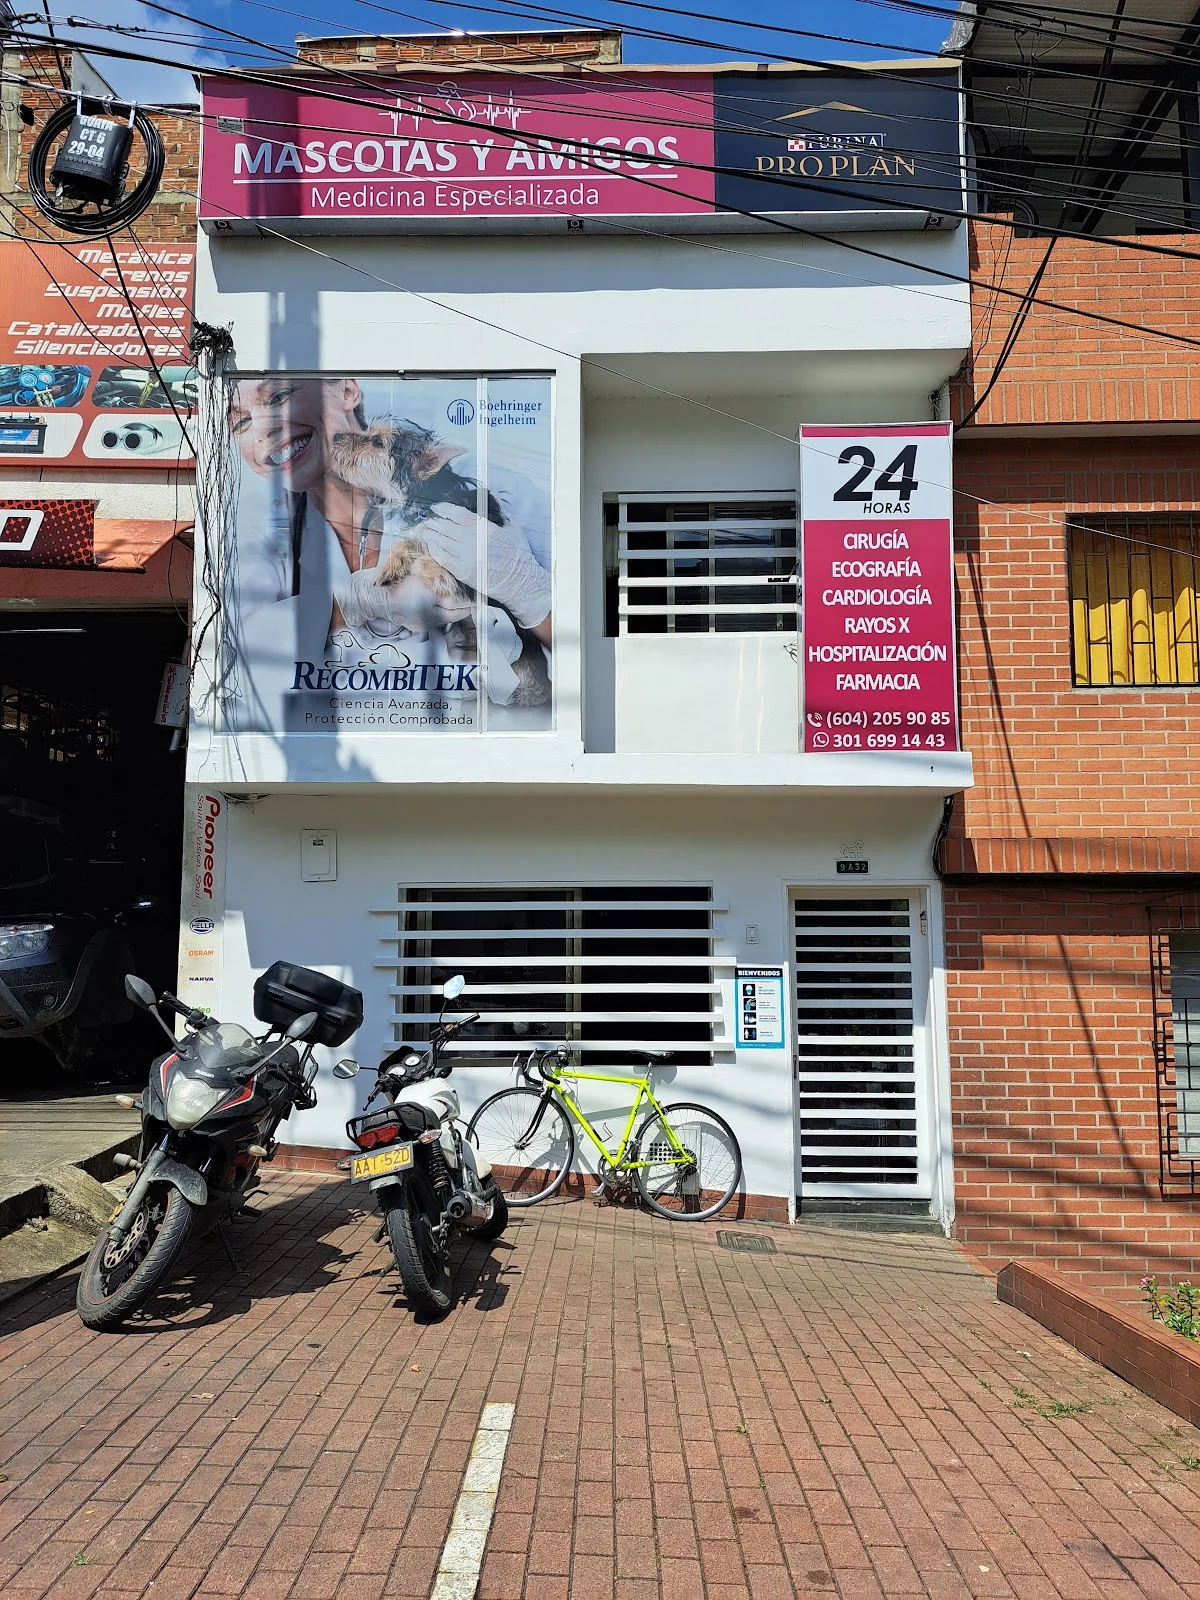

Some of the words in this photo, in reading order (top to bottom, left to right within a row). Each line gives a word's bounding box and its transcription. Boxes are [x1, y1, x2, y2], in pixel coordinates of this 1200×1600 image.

[67, 140, 106, 160] 29-04
[233, 139, 458, 174] MASCOTAS
[468, 138, 494, 171] Y
[505, 136, 680, 171] AMIGOS
[755, 155, 823, 177] PRO
[829, 155, 916, 177] PLAN
[311, 185, 425, 208] Medicina
[435, 183, 600, 212] Especializada
[76, 249, 194, 265] Mecánica
[98, 268, 191, 283] Frenos
[44, 283, 188, 303] Suspensión
[96, 303, 188, 319] Mofles
[7, 321, 186, 338] Catalizadores
[13, 340, 185, 357] Silenciadores
[478, 399, 542, 413] Boehringer
[478, 414, 536, 427] Ingelheim
[832, 444, 919, 502] 24
[863, 502, 911, 514] HORAS
[843, 528, 910, 550] CIRUGÍA
[831, 557, 922, 578] ECOGRAFÍA
[822, 584, 933, 606] CARDIOLOGÍA
[844, 617, 897, 634] RAYOS
[898, 616, 911, 634] X
[808, 641, 947, 662] HOSPITALIZACIÓN
[836, 673, 921, 691] FARMACIA
[329, 698, 384, 710] Ciencia
[387, 698, 453, 712] Avanzada,
[304, 712, 385, 725] Protección
[389, 712, 473, 728] Comprobada
[826, 711, 868, 729] (604)
[872, 711, 902, 726] 205
[906, 711, 927, 726] 90
[931, 711, 951, 726] 85
[833, 733, 863, 748] 301
[867, 733, 897, 748] 699
[901, 733, 921, 748] 14
[925, 733, 946, 748] 43
[203, 794, 221, 900] Pioneer
[188, 949, 214, 957] OSRAM
